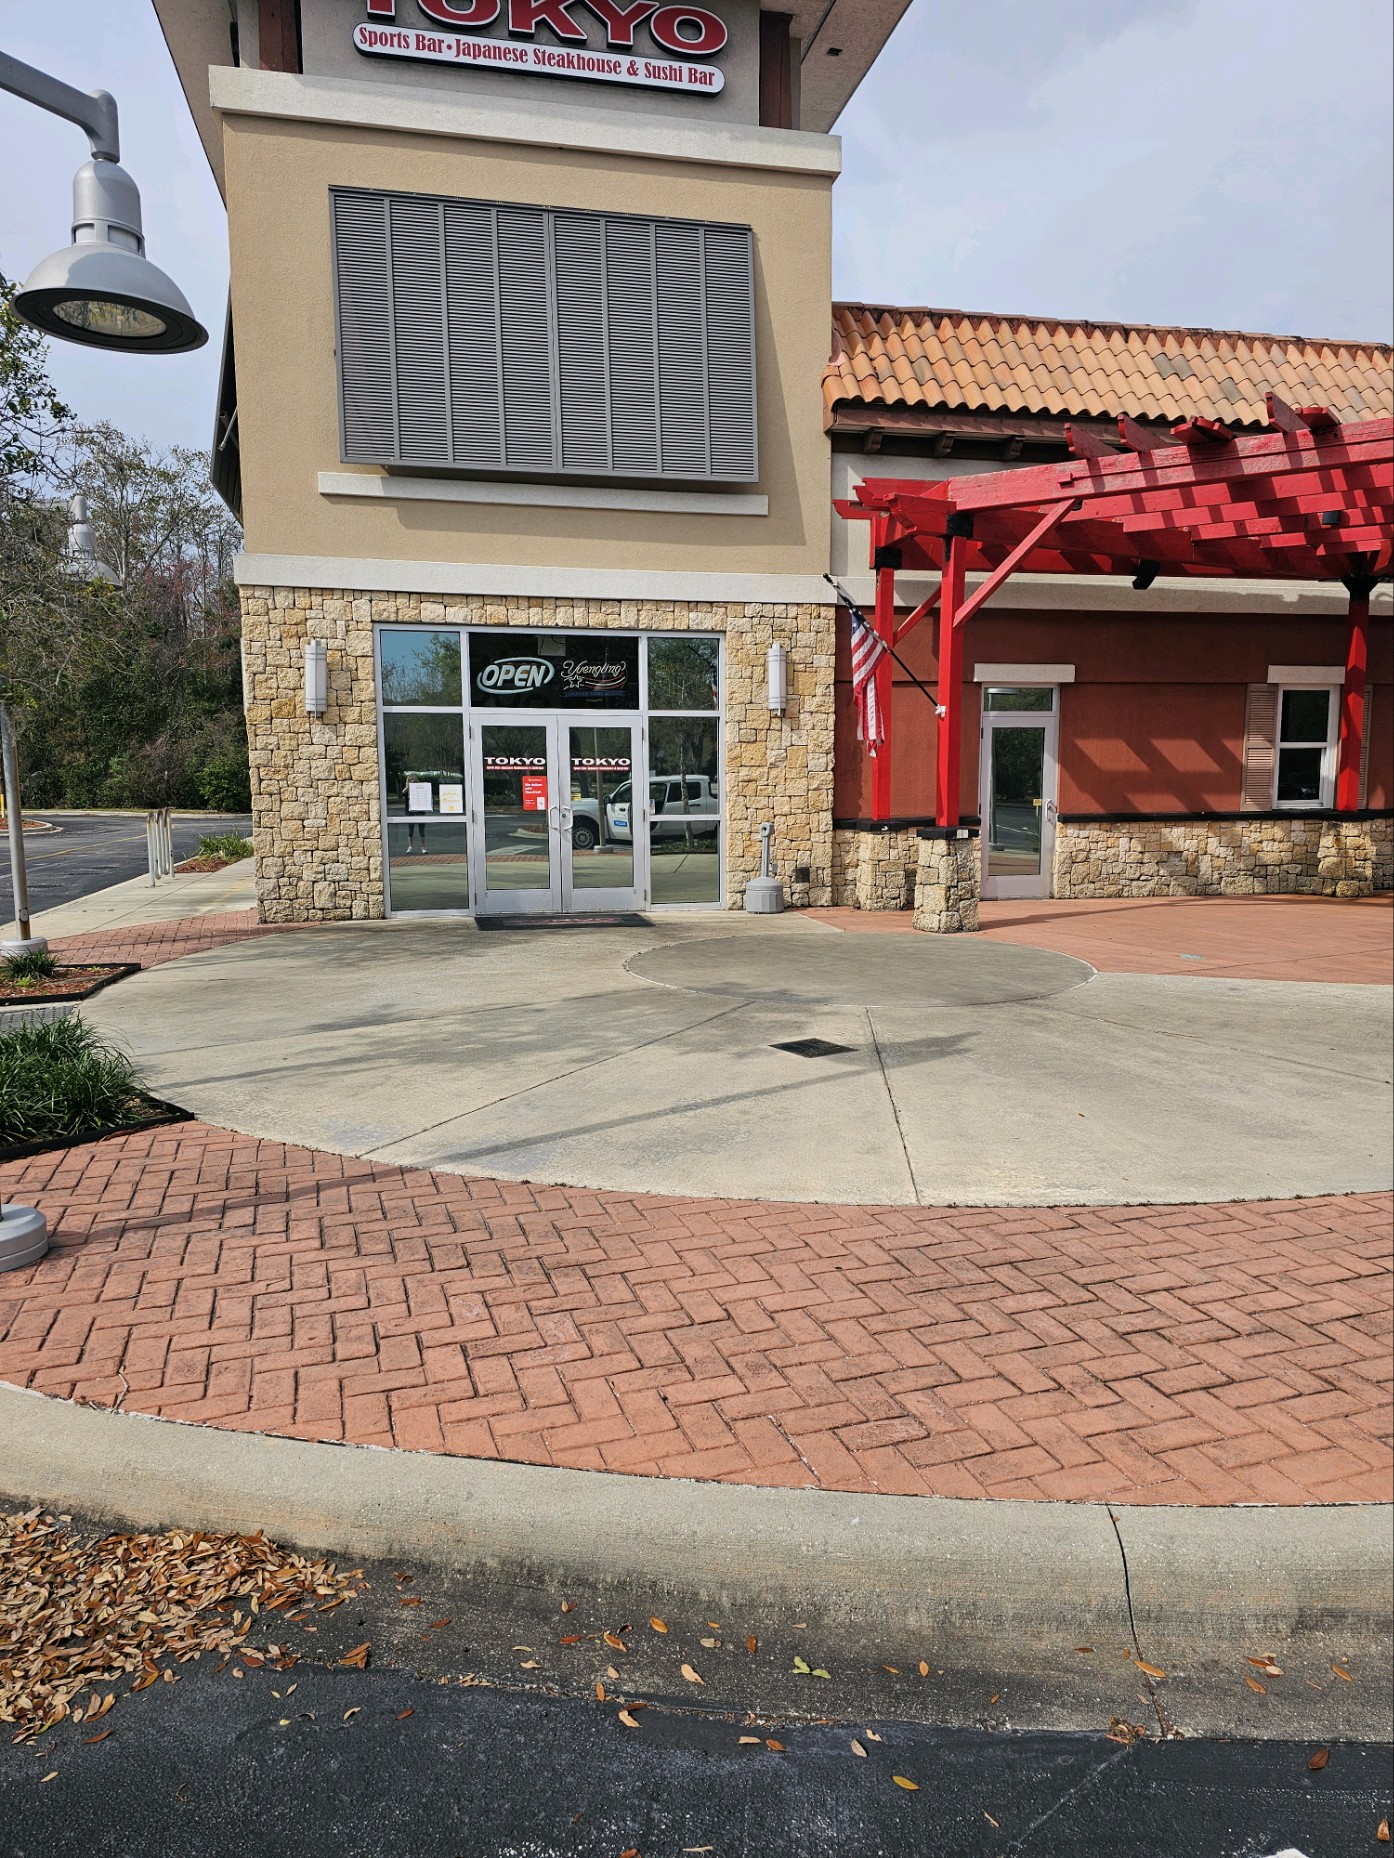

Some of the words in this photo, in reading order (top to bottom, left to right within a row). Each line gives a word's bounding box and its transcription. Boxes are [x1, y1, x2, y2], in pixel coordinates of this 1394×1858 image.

[359, 26, 410, 50] Sports
[415, 33, 445, 54] Bar
[454, 38, 529, 64] Japanese
[533, 48, 622, 75] Steakhouse
[626, 60, 640, 77] &
[644, 62, 683, 83] Sushi
[687, 67, 716, 86] Bar
[481, 664, 546, 687] OPEN
[560, 660, 627, 678] Yuengling
[484, 757, 546, 765] TOKYO
[571, 758, 631, 766] TOKYO
